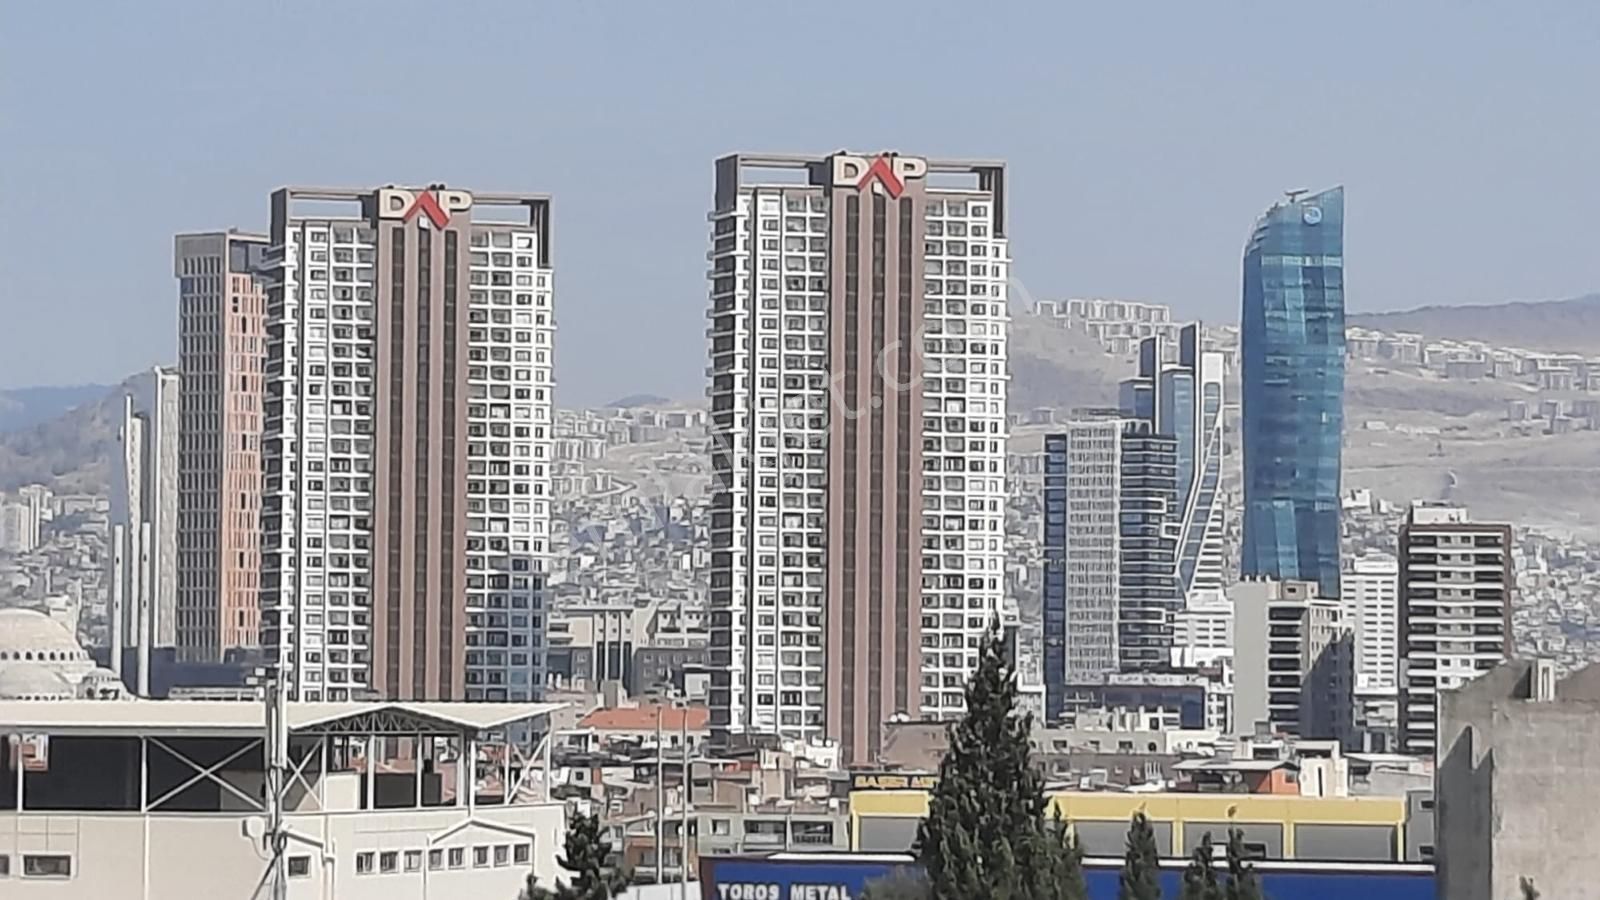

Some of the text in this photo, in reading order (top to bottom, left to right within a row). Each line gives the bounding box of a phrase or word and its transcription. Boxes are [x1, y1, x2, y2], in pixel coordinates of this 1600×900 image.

[834, 155, 927, 200] DAP
[379, 188, 472, 231] DAP
[717, 883, 851, 900] TOROS METAL
